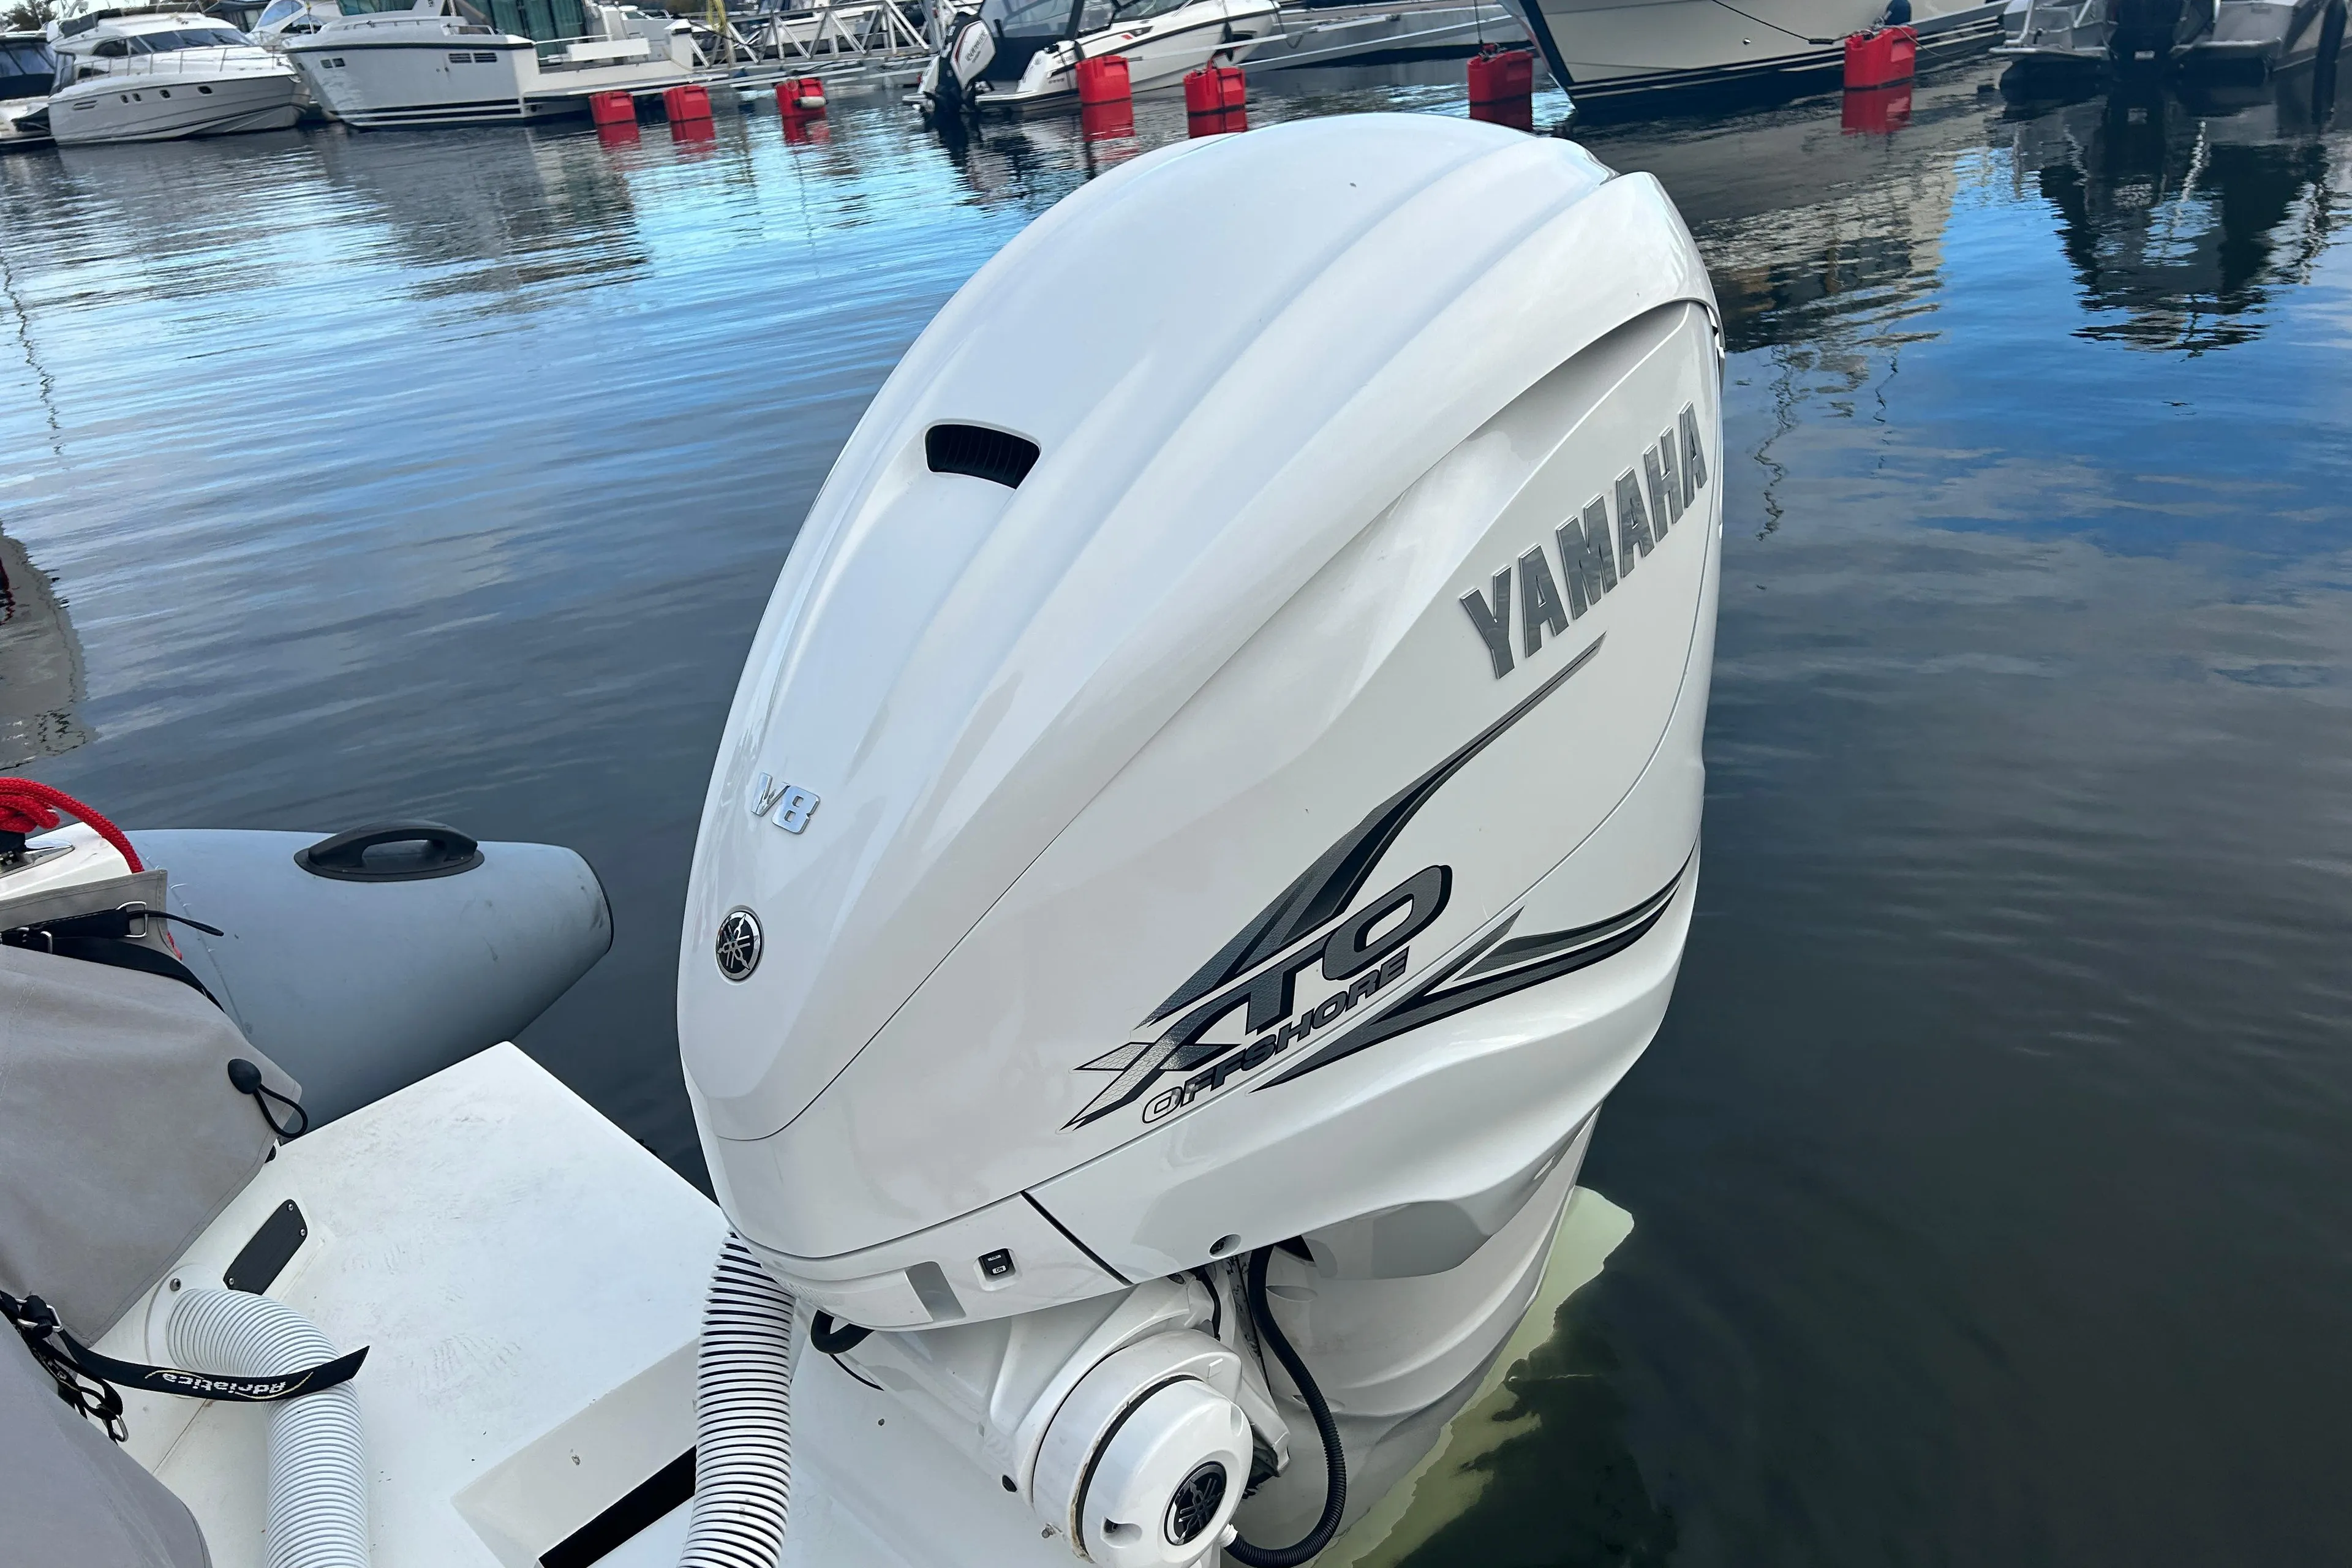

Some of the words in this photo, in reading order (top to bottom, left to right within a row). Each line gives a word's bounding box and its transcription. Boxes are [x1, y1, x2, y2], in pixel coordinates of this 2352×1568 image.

[1459, 401, 1708, 679] YAMAHA
[751, 772, 821, 835] V8
[1058, 864, 1453, 1131] XTO
[1142, 945, 1410, 1124] OFFSHORE
[162, 1372, 287, 1395] Adriatica
